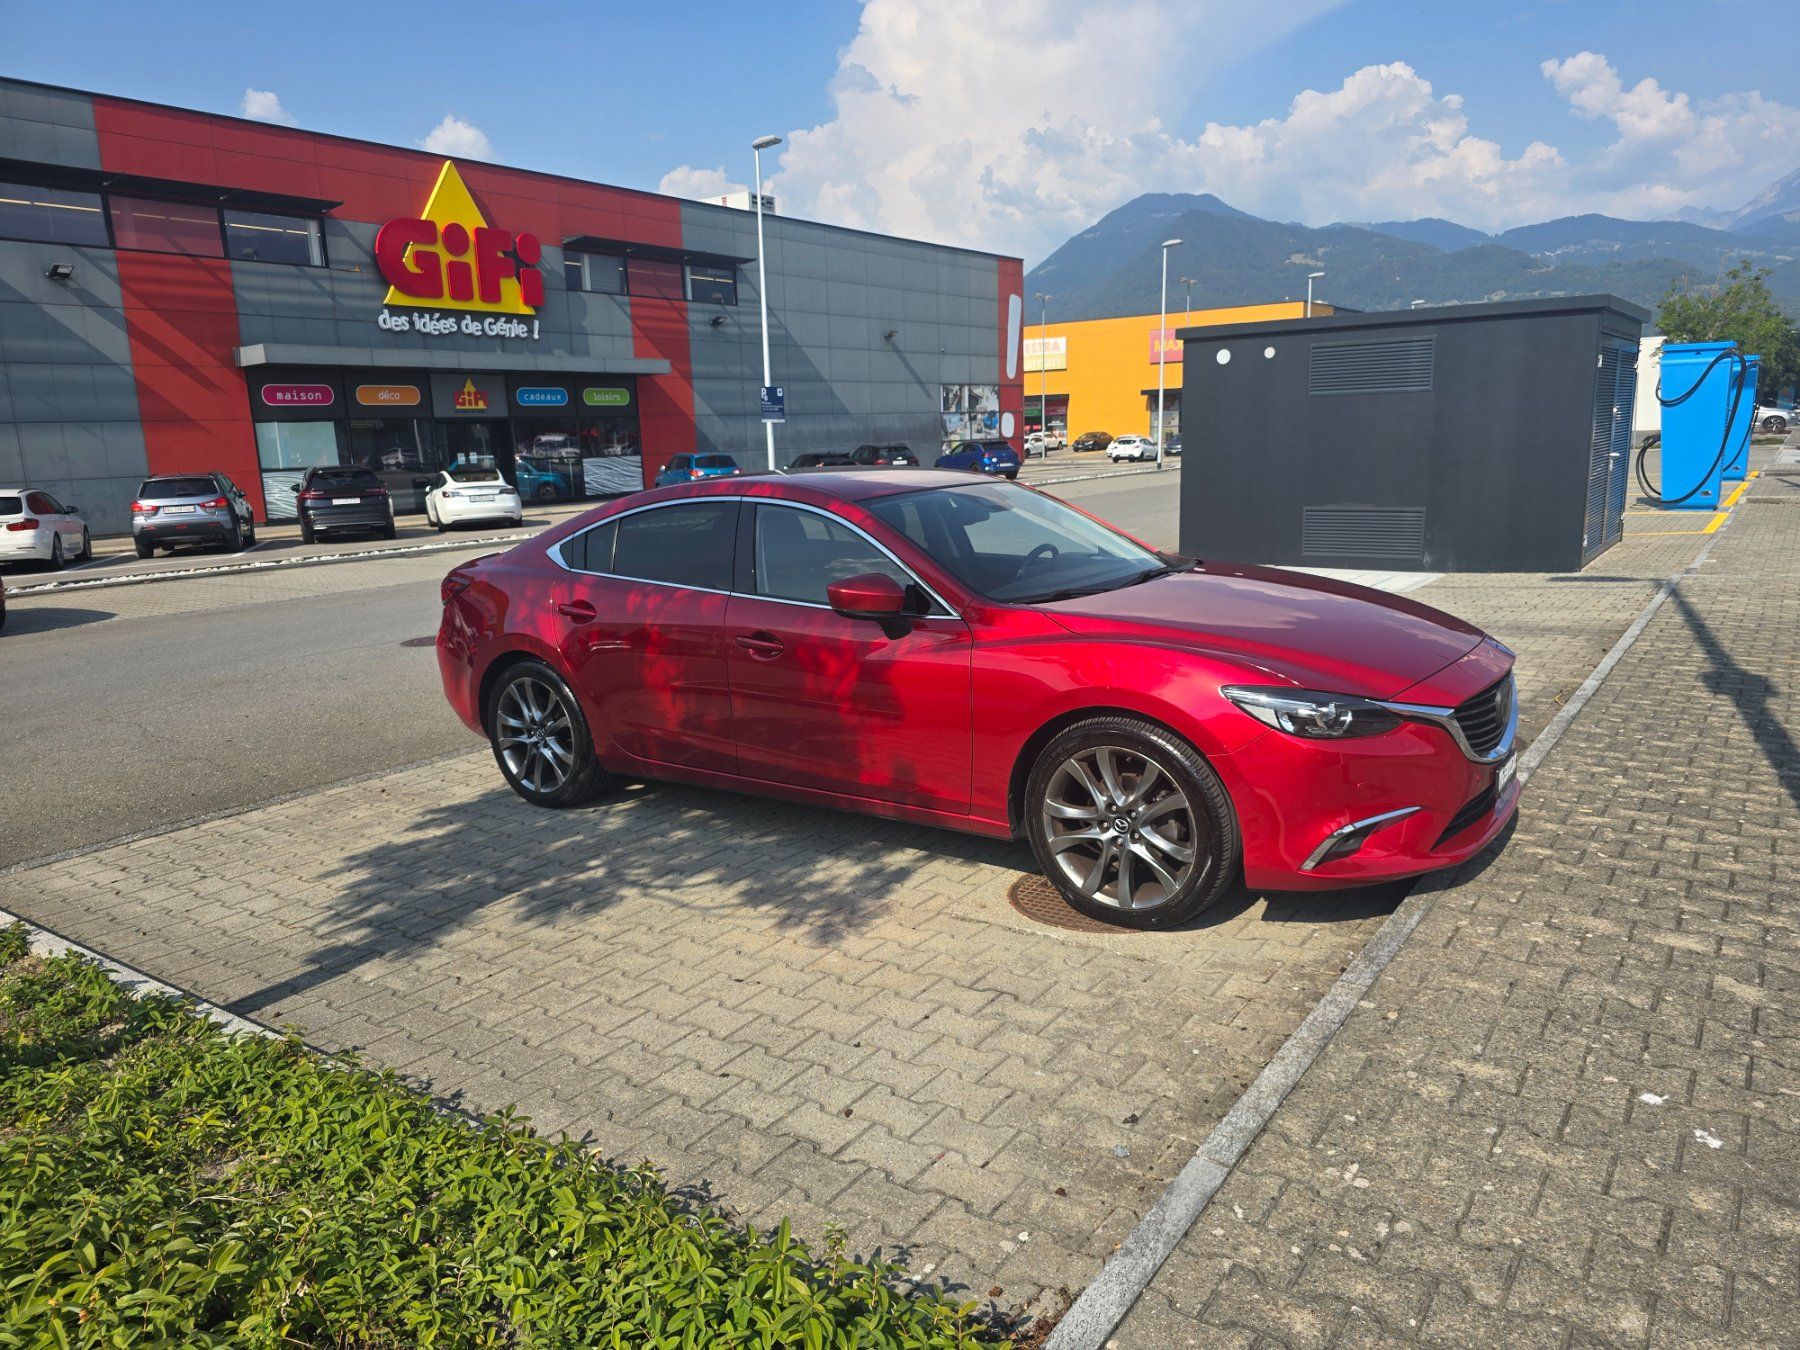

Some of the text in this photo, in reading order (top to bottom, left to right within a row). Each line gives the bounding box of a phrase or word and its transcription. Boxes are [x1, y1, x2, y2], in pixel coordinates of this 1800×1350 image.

[375, 217, 545, 307] GiFi
[377, 308, 410, 331] des
[412, 312, 458, 335] idées
[460, 314, 483, 337] de
[483, 317, 528, 339] Génie
[276, 390, 322, 400] maison
[378, 389, 400, 400] déco
[523, 392, 562, 401] cadeaux
[593, 392, 621, 401] loisirs
